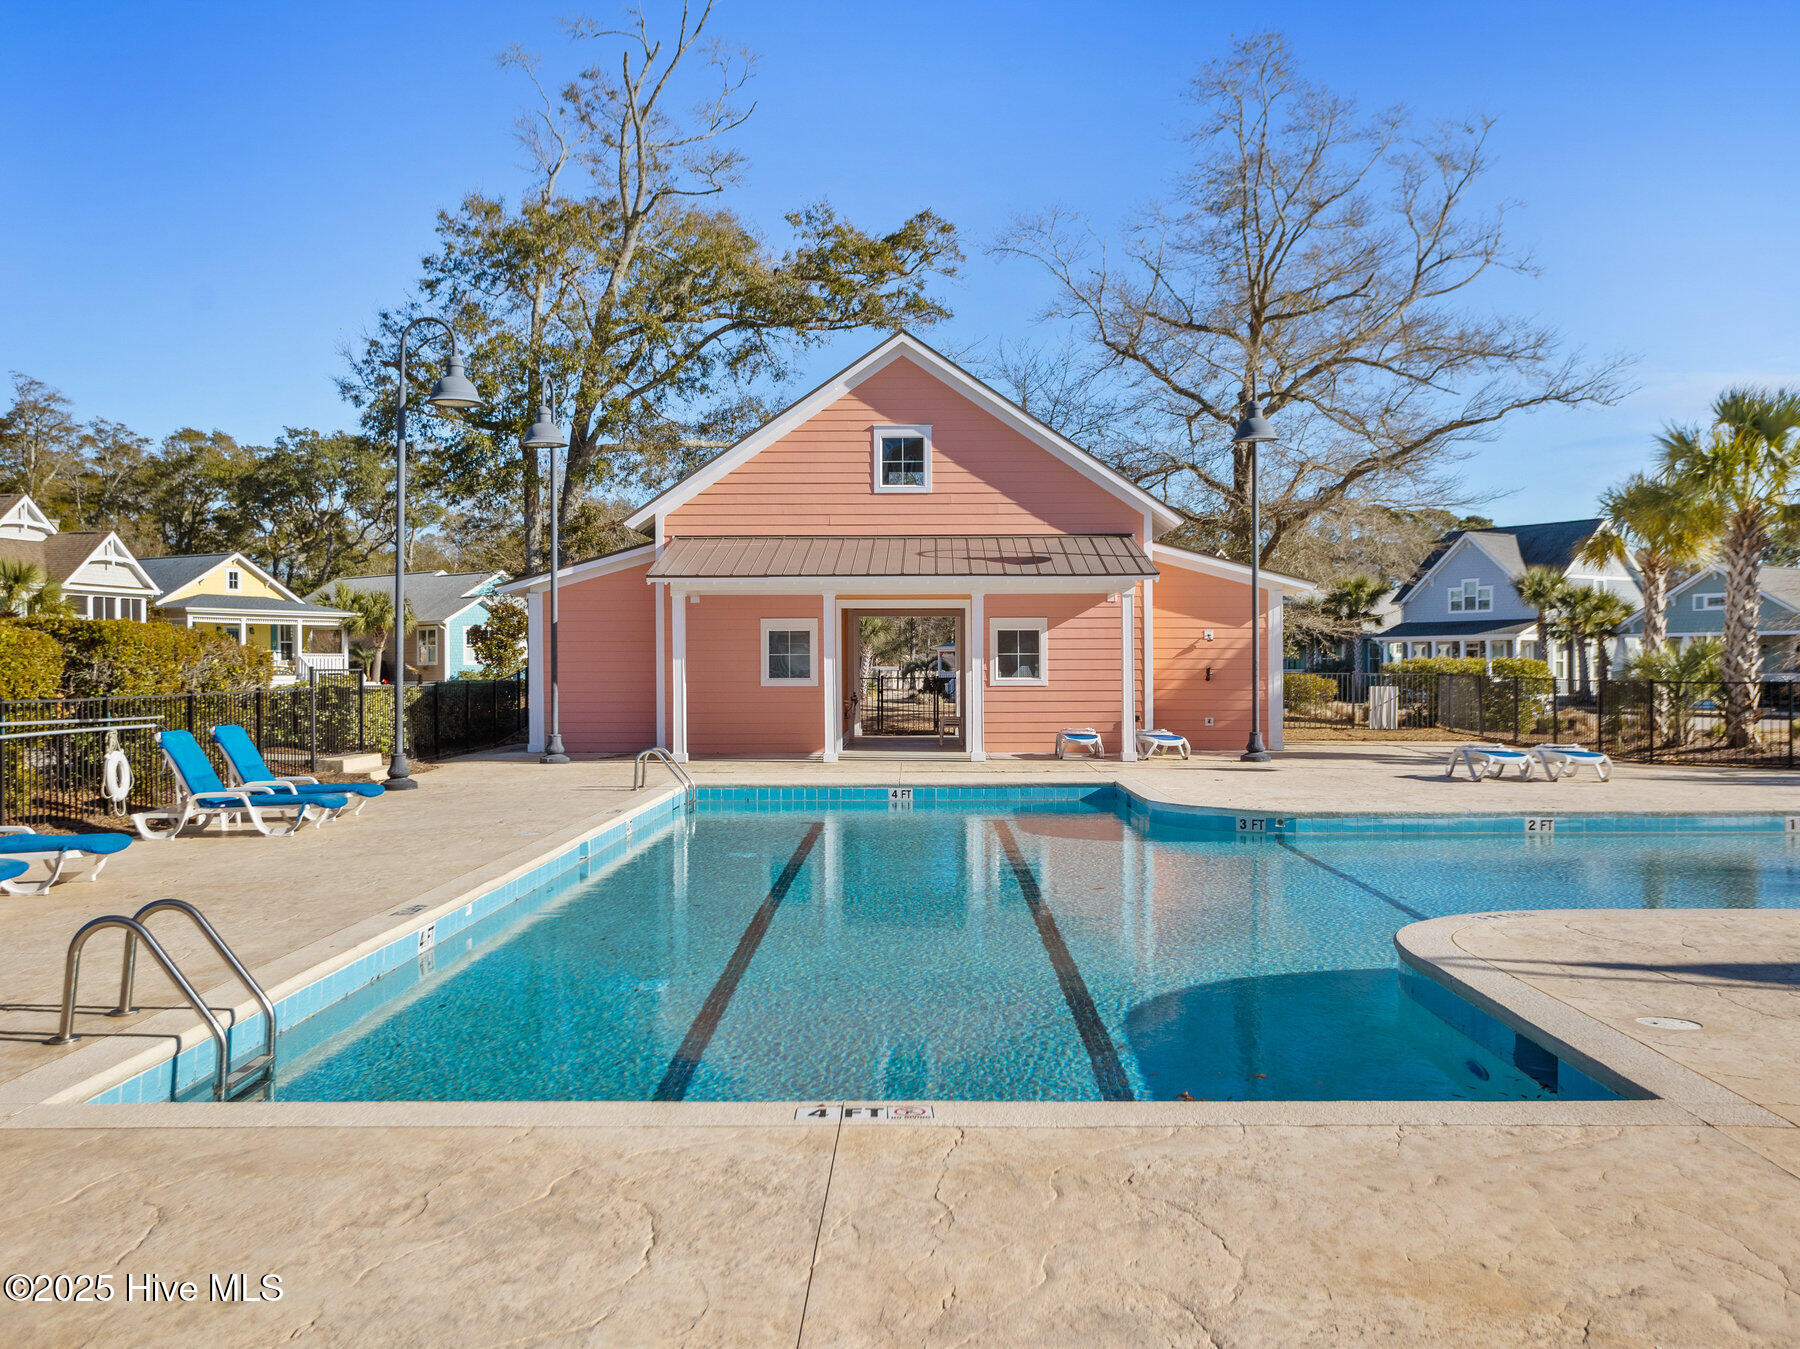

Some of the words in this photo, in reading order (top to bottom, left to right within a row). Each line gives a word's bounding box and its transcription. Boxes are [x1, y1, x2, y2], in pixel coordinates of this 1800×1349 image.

[891, 790, 898, 799] 4
[901, 790, 911, 799] FT
[1239, 819, 1247, 830] 3
[1251, 819, 1265, 831] FT
[1528, 820, 1536, 831] 2
[1540, 820, 1554, 831] FT
[807, 1108, 828, 1118] 4
[844, 1107, 884, 1118] FT
